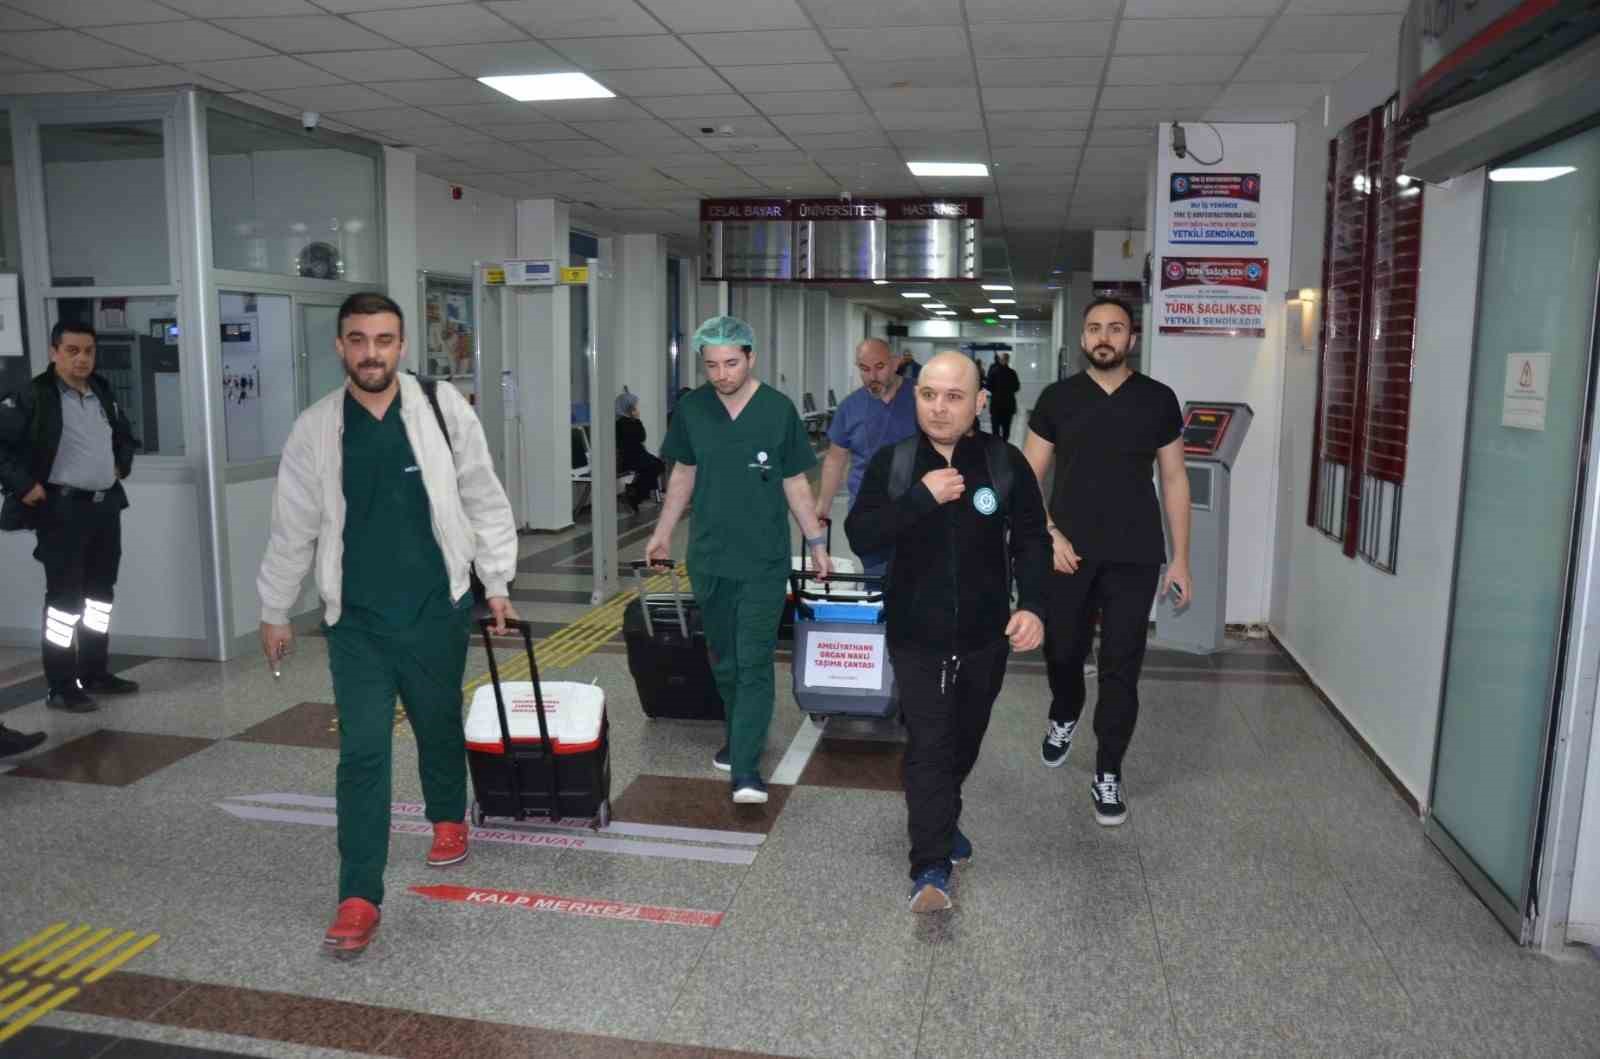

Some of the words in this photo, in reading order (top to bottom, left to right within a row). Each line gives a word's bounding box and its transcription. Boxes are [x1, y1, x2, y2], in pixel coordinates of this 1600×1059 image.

[744, 205, 782, 217] BAYAR
[799, 202, 879, 217] ÜNİVERSİTESİ
[1173, 228, 1203, 238] YETKİLİ
[1205, 228, 1255, 238] SENDİKADIR
[1166, 299, 1194, 314] TÜRK
[1198, 299, 1261, 314] SAĞLIK-SEN
[1165, 315, 1200, 325] YETKİLİ
[820, 651, 846, 659] ORGAN
[473, 831, 585, 848] ORATUVAR
[466, 890, 531, 906] KALP
